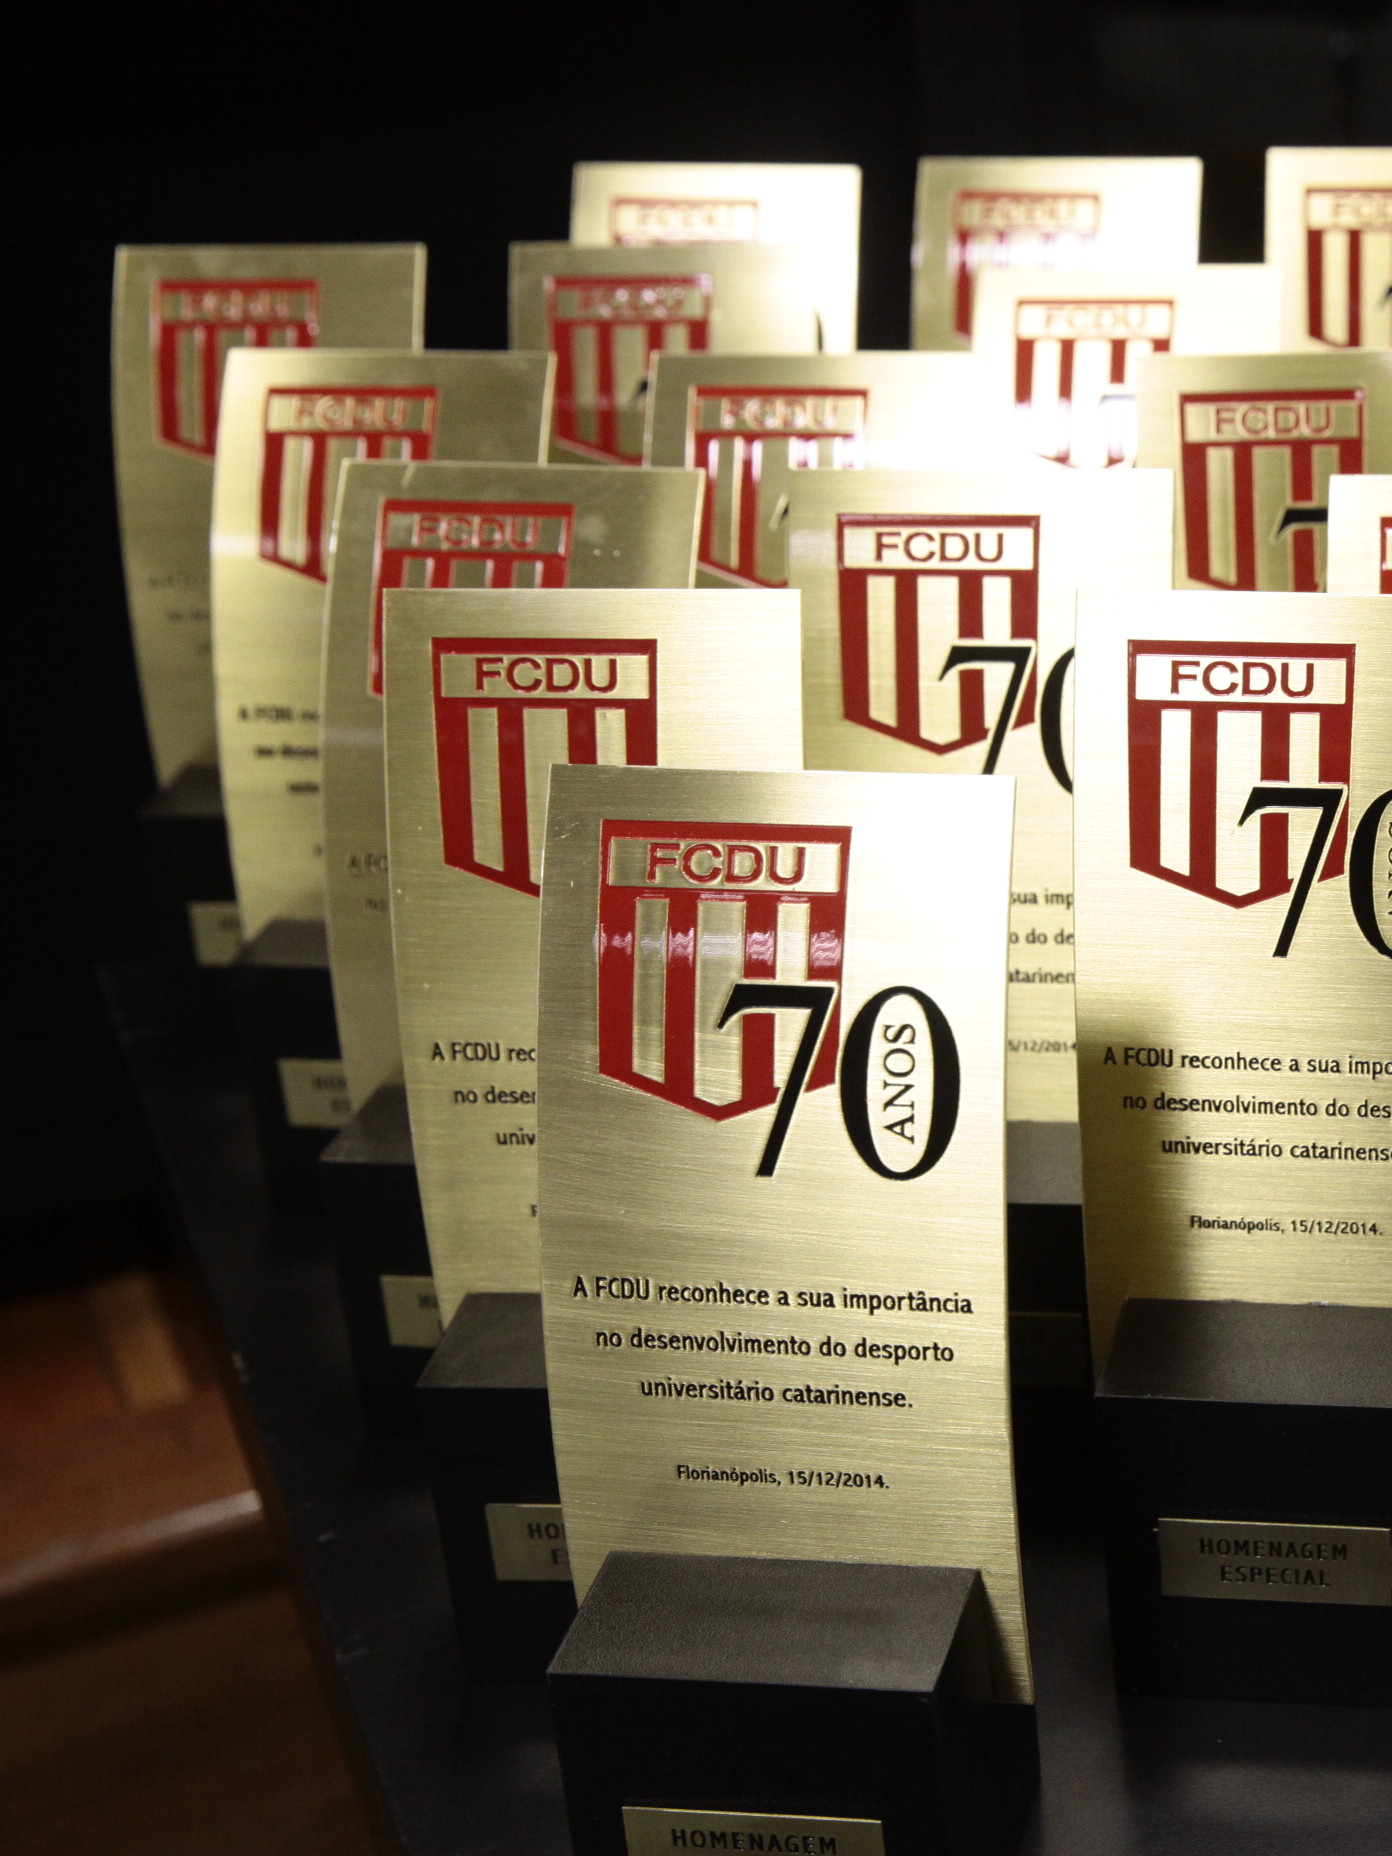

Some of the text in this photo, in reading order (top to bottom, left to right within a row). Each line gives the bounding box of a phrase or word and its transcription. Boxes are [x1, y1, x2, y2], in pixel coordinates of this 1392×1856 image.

[1215, 405, 1332, 437] FCDU
[415, 515, 542, 550] FCDU
[874, 531, 1004, 563] FCDU
[474, 656, 618, 694] FCDU
[1170, 660, 1315, 698] FCDU
[645, 842, 806, 886] FCDU
[1026, 928, 1048, 945] do
[431, 1042, 445, 1061] A
[452, 1042, 500, 1062] FCDU
[1103, 1047, 1117, 1066] A
[1123, 1047, 1174, 1068] FCDU
[1180, 1051, 1282, 1073] reconhece
[1289, 1056, 1300, 1073] a
[1306, 1057, 1341, 1074] sua
[454, 1089, 478, 1104] no
[717, 984, 961, 1182] 70
[883, 1022, 917, 1145] ANOS
[1122, 1093, 1147, 1111] no
[1154, 1092, 1318, 1117] desenvolvimento
[1325, 1098, 1350, 1117] do
[1162, 1136, 1283, 1158] universitário
[1190, 1215, 1383, 1237] Florianópolis, 15/12/2014.
[572, 1275, 974, 1317] A FCDU reconhece a sua importância
[595, 1327, 955, 1366] no desenvolvimento do desporto
[640, 1376, 914, 1409] universitário catarinense.
[676, 1464, 891, 1490] Florianópolis, 15/12/2014.
[1199, 1537, 1348, 1561] HOMENAGEM
[1220, 1564, 1332, 1588] ESPECIAL
[671, 1828, 838, 1856] HOMENAGEM
